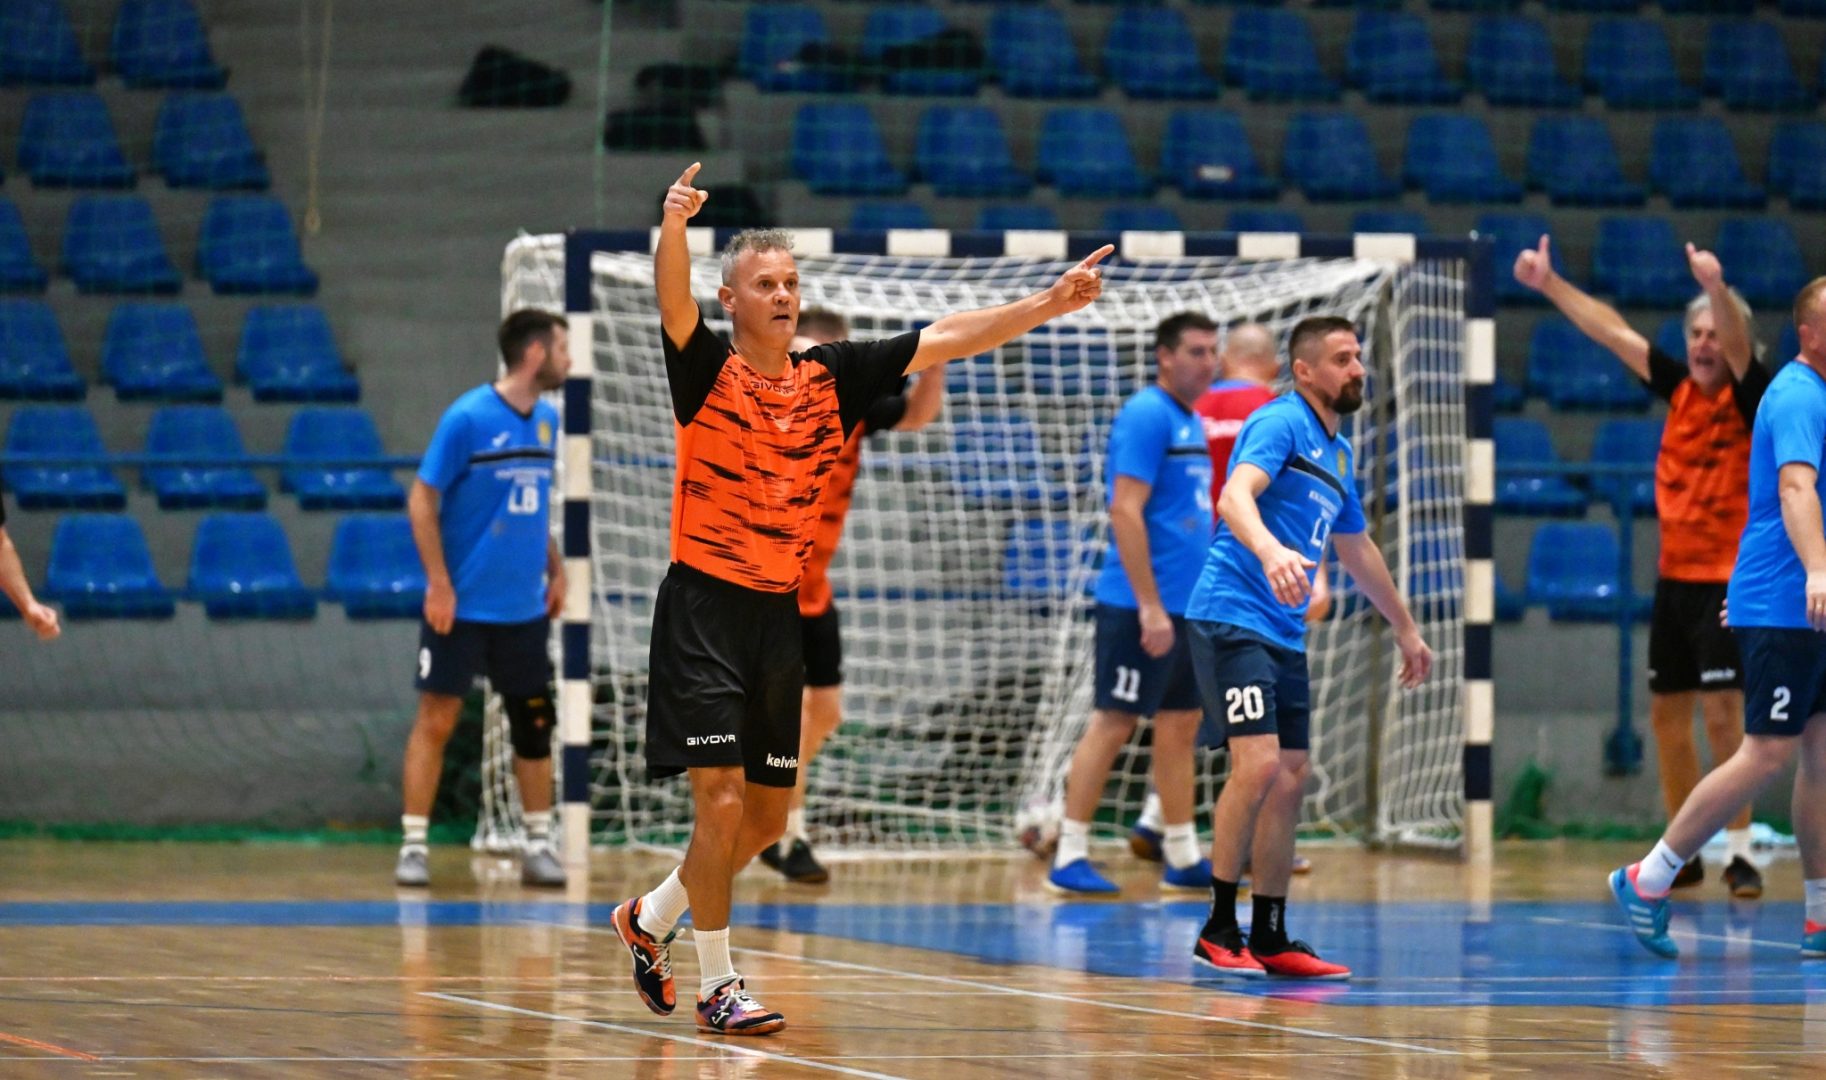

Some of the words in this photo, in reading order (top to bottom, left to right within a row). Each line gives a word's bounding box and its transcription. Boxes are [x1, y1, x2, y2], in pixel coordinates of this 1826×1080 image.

[418, 647, 432, 679] 9
[1111, 665, 1141, 703] 11
[1225, 685, 1265, 724] 20
[1769, 685, 1791, 720] 2
[766, 752, 799, 769] kelvin
